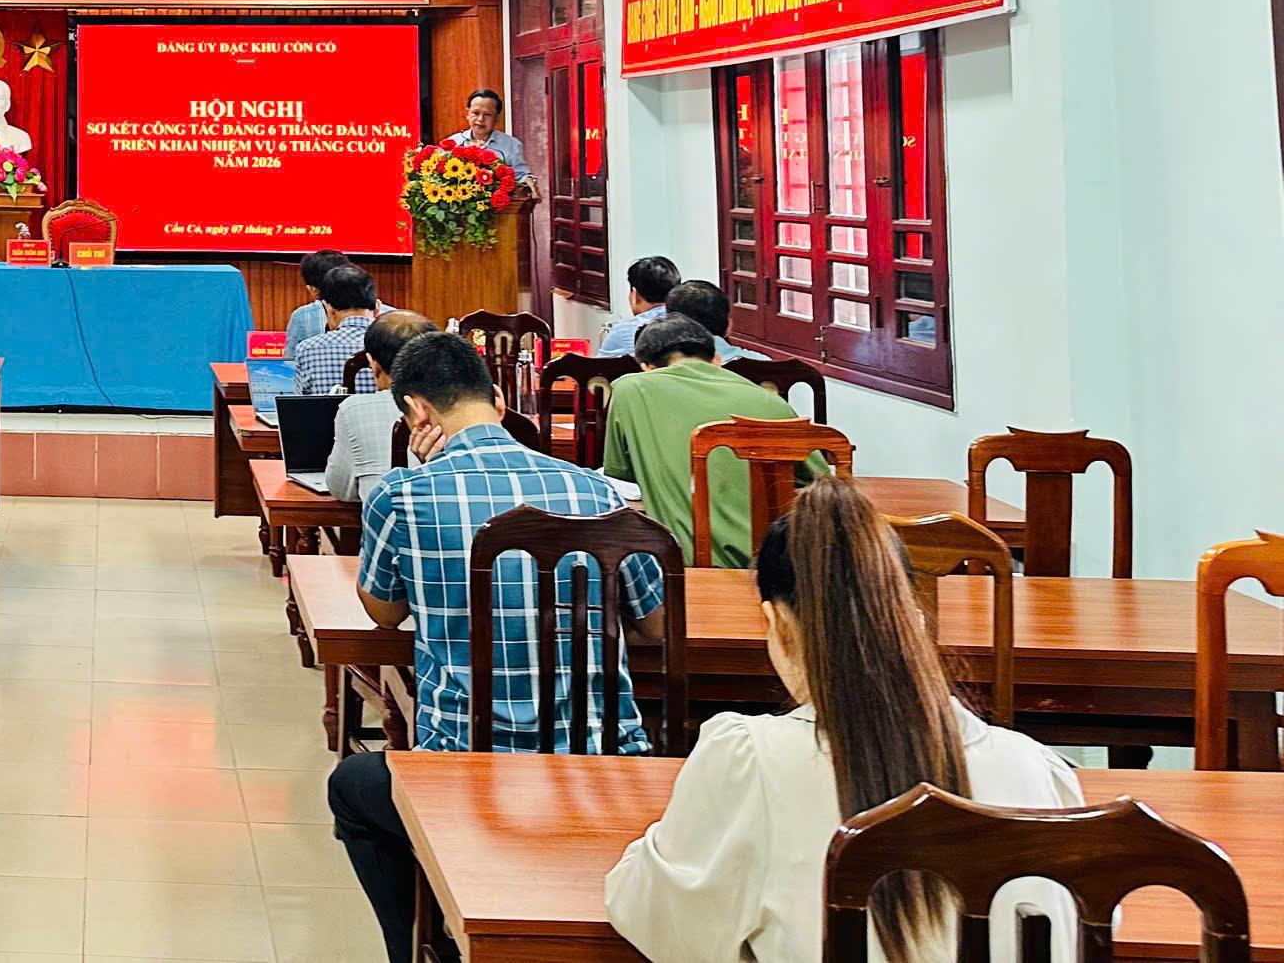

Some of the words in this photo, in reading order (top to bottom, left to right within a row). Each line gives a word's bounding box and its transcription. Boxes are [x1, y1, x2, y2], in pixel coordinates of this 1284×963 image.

[251, 42, 281, 53] KHU
[189, 98, 234, 122] HỘI
[241, 100, 304, 122] NGHỊ
[86, 122, 107, 135] SƠ
[109, 121, 140, 135] KẾT
[142, 120, 186, 135] CÔNG
[188, 120, 221, 135] TÁC
[223, 121, 265, 136] ĐẢNG
[267, 124, 277, 136] 6
[278, 122, 332, 136] THÁNG
[111, 138, 156, 151] TRIỂN
[159, 139, 198, 151] KHAI
[201, 139, 251, 154] NHIỆM
[255, 140, 276, 154] VỤ
[278, 141, 287, 152] 6
[289, 138, 344, 152] THÁNG
[214, 154, 249, 168] NĂM
[252, 156, 281, 168] 2026
[205, 225, 229, 235] ngày
[231, 224, 244, 234] 07
[245, 223, 273, 236] tháng
[275, 225, 282, 234] 7
[284, 225, 306, 234] năm
[309, 225, 332, 234] 2026
